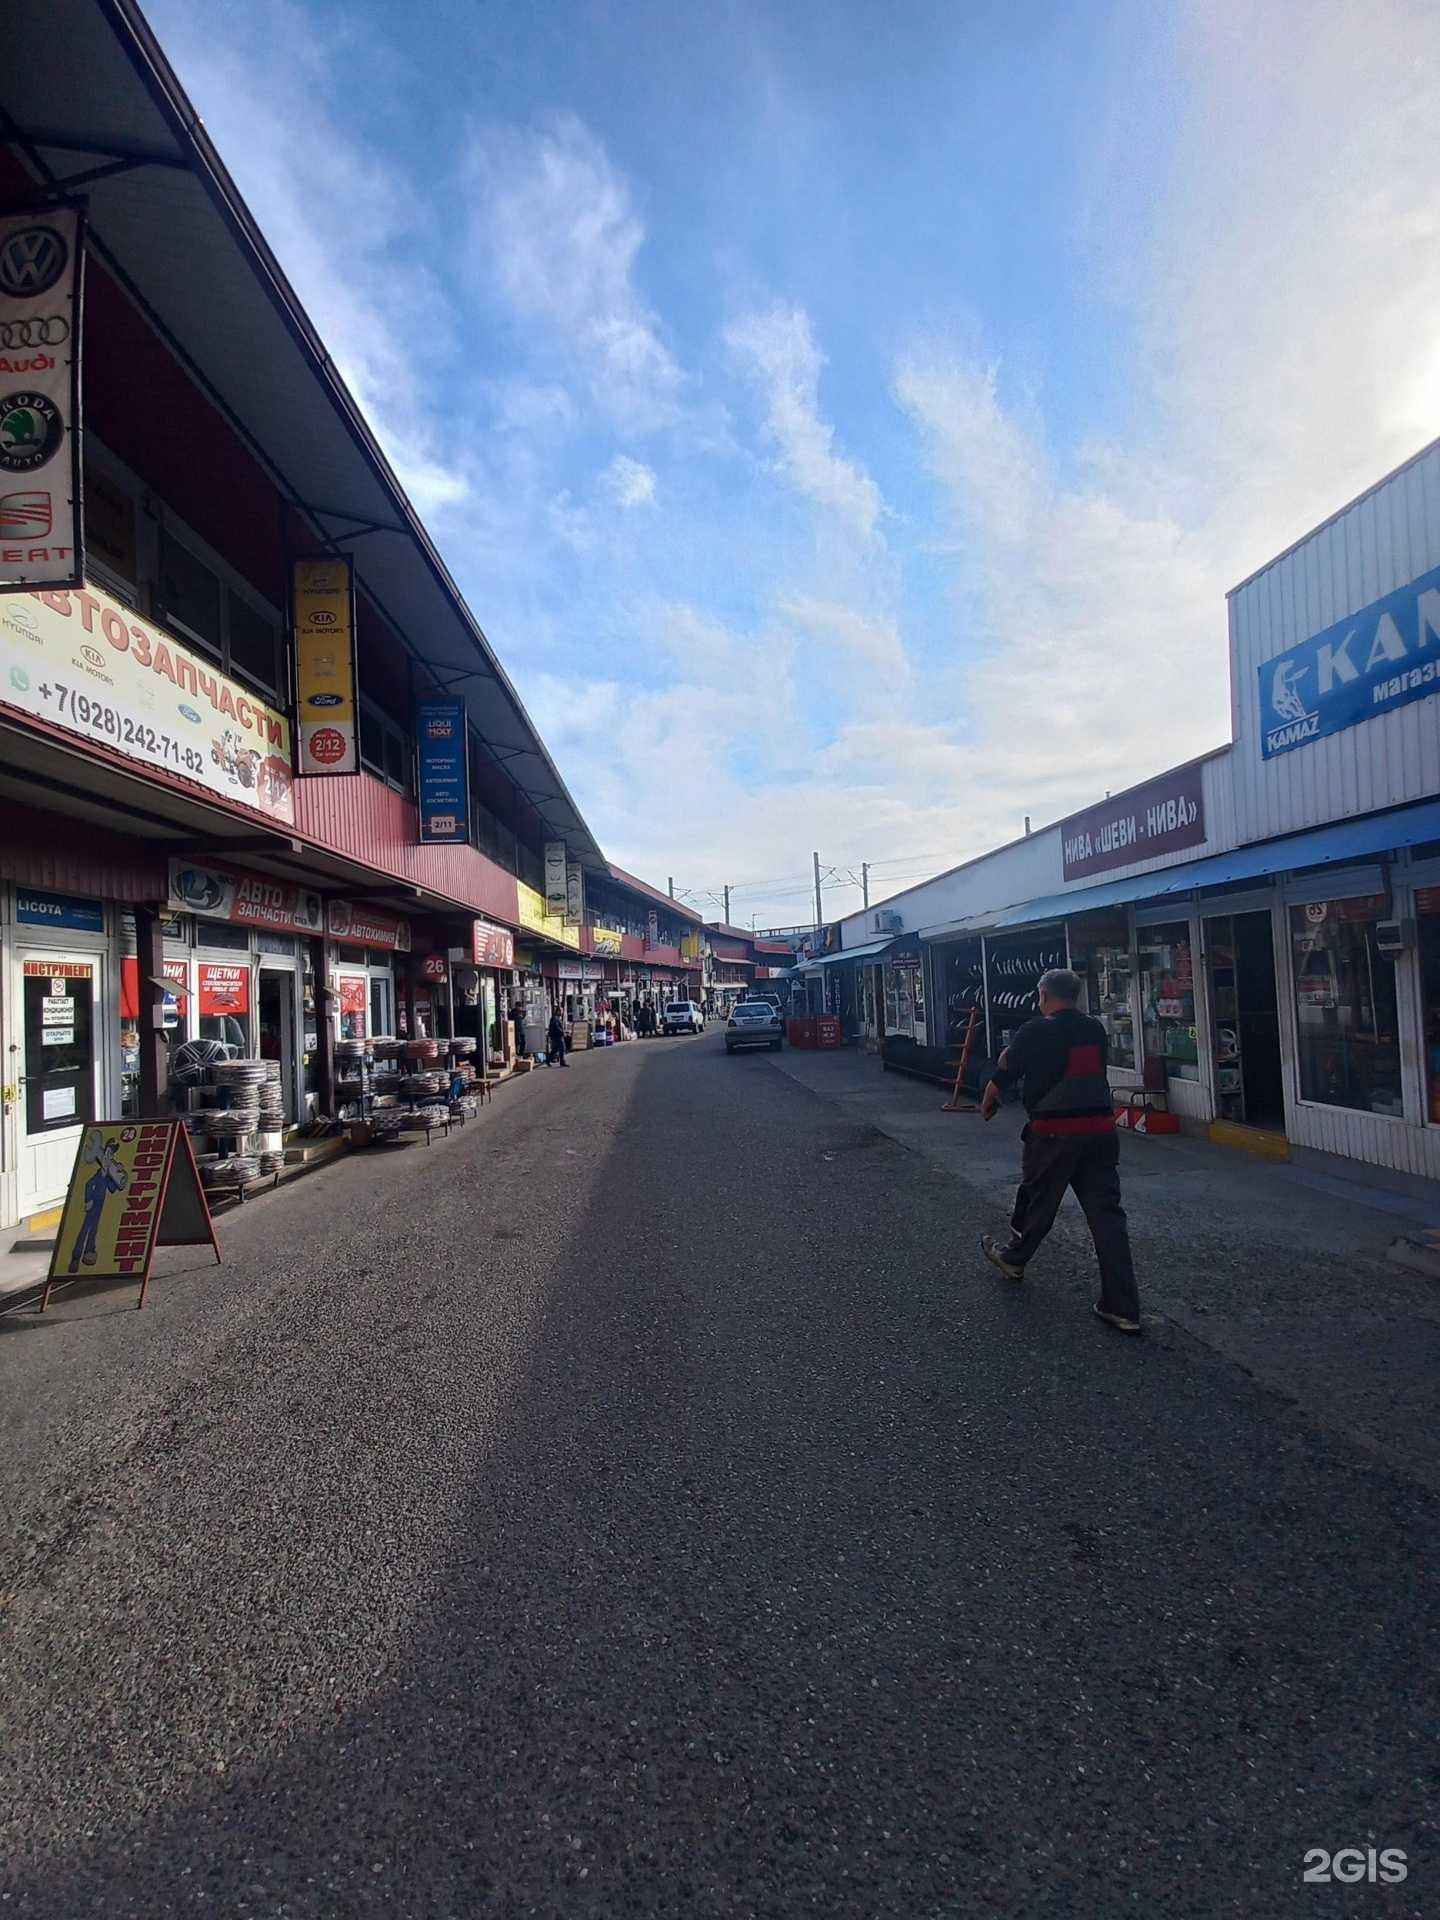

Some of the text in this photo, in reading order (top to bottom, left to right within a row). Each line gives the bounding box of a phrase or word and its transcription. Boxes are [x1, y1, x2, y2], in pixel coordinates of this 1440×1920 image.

[0, 395, 56, 423] KODA
[0, 546, 72, 563] EAT
[2, 618, 43, 646] HYUNDAI
[84, 648, 102, 665] KIA
[30, 591, 283, 749] ВТОЗАПЧАСТИ
[38, 682, 204, 774] +7(928)242-71-82
[1267, 715, 1321, 752] KAMAZ
[315, 739, 340, 751] 2/12
[1065, 833, 1092, 864] НИВА
[1095, 816, 1136, 853] «ШЕВИ
[1147, 796, 1197, 837] НИВА»
[238, 879, 282, 908] АВТО
[18, 900, 62, 916] LICOTA
[238, 903, 293, 924] ЗАПЧАСТИ
[351, 924, 395, 945] АВТОХИМИЯ
[24, 962, 91, 977] ИНСТРУМЕНТ
[207, 967, 240, 980] ЩЕТКИ
[426, 961, 443, 974] 26
[113, 1125, 169, 1273] ИНСТРУМЕНТ
